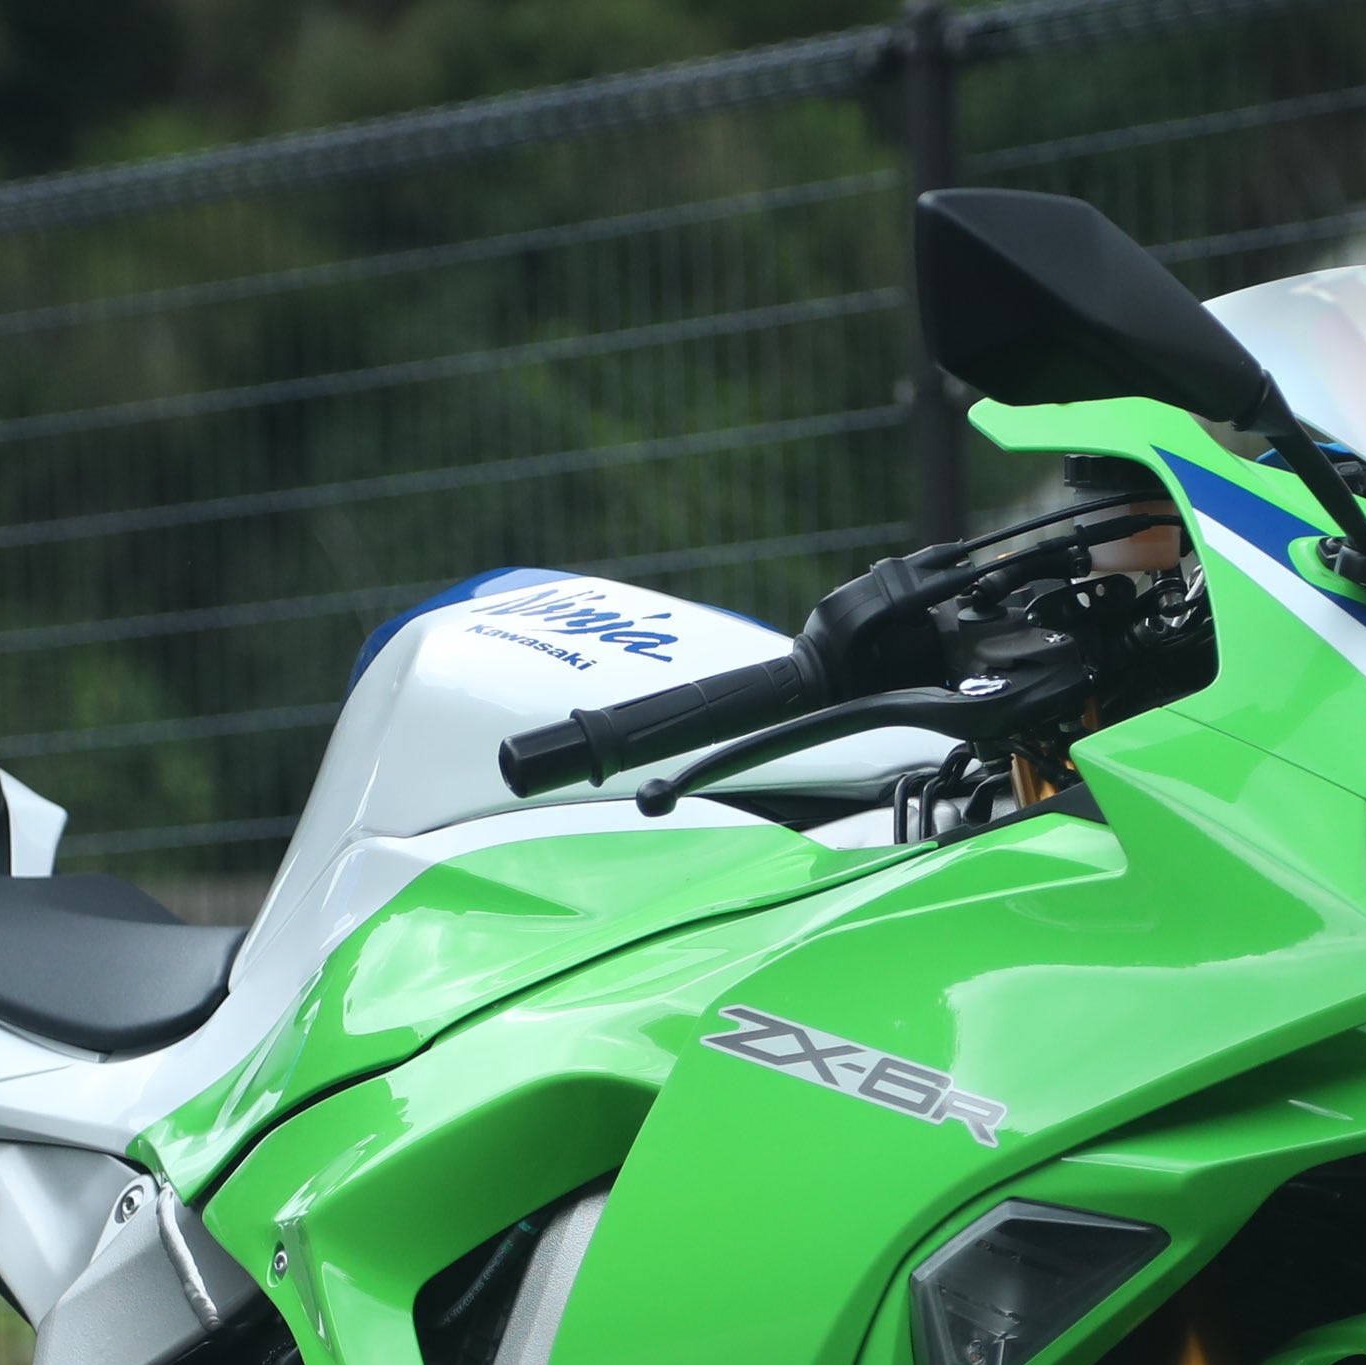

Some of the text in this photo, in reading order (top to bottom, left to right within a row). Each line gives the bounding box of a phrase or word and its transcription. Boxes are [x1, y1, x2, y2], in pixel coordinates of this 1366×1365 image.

[464, 623, 598, 671] Kawasaki
[469, 588, 679, 663] Ninja
[700, 1005, 1006, 1148] ZX-6R
